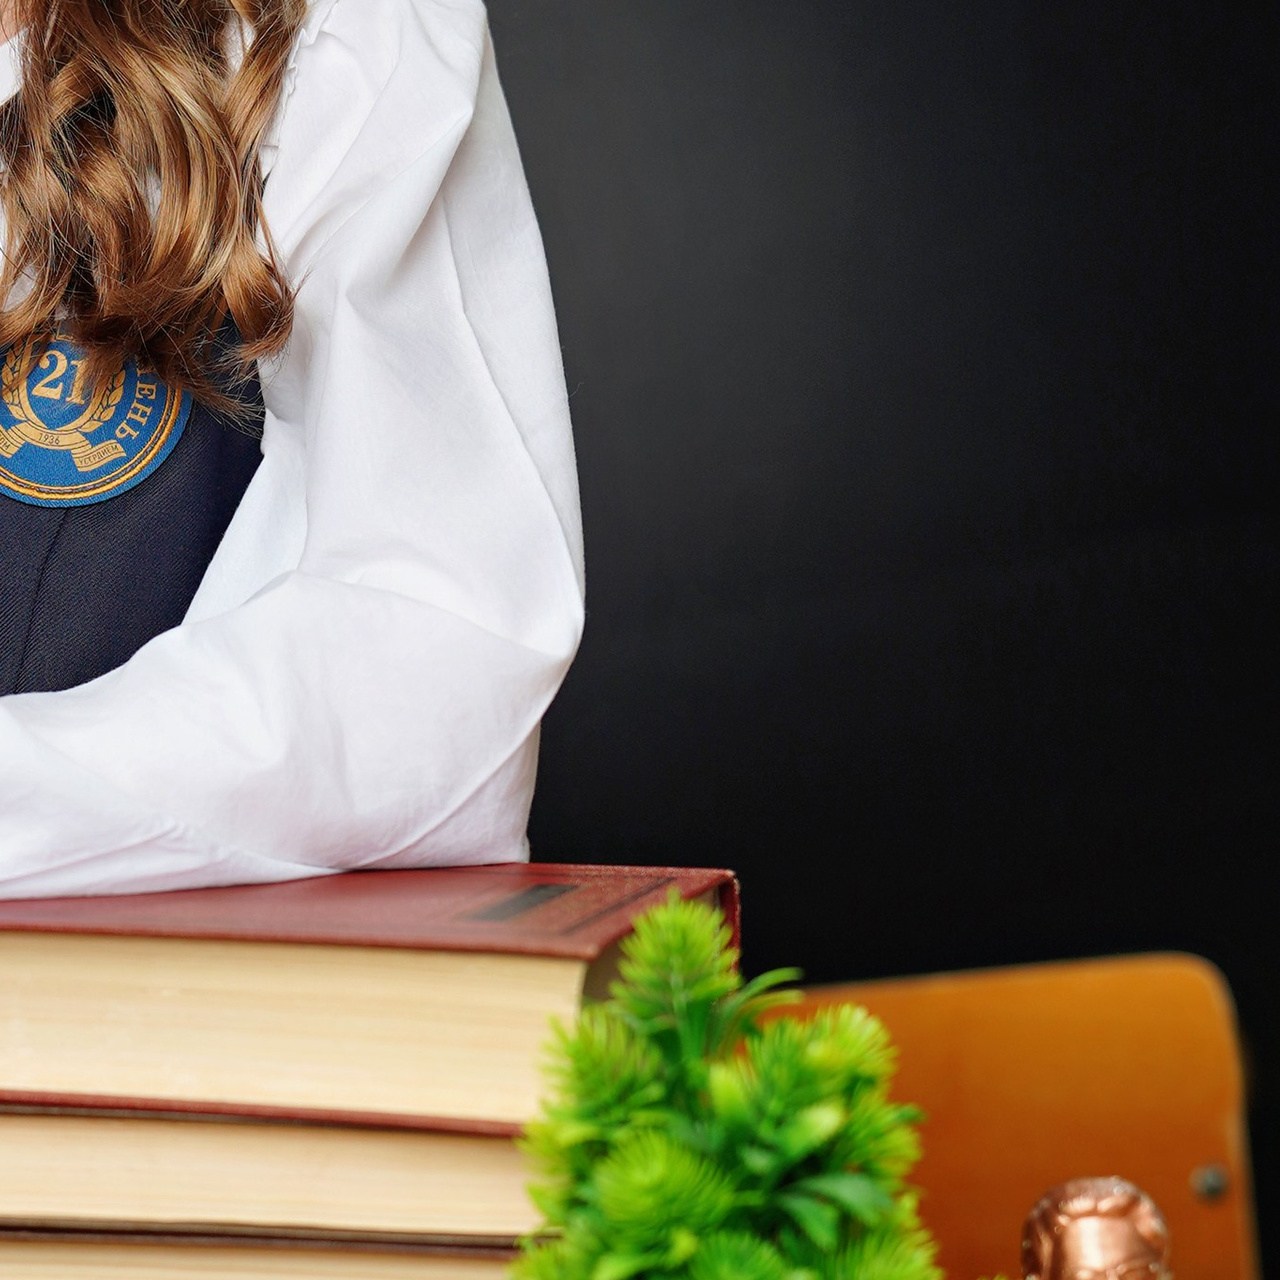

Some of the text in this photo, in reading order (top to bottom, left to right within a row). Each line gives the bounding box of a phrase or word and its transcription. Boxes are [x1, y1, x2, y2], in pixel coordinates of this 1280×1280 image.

[32, 350, 85, 405] 21
[38, 432, 61, 445] 1936
[79, 444, 119, 466] УСЕРДИЕМ
